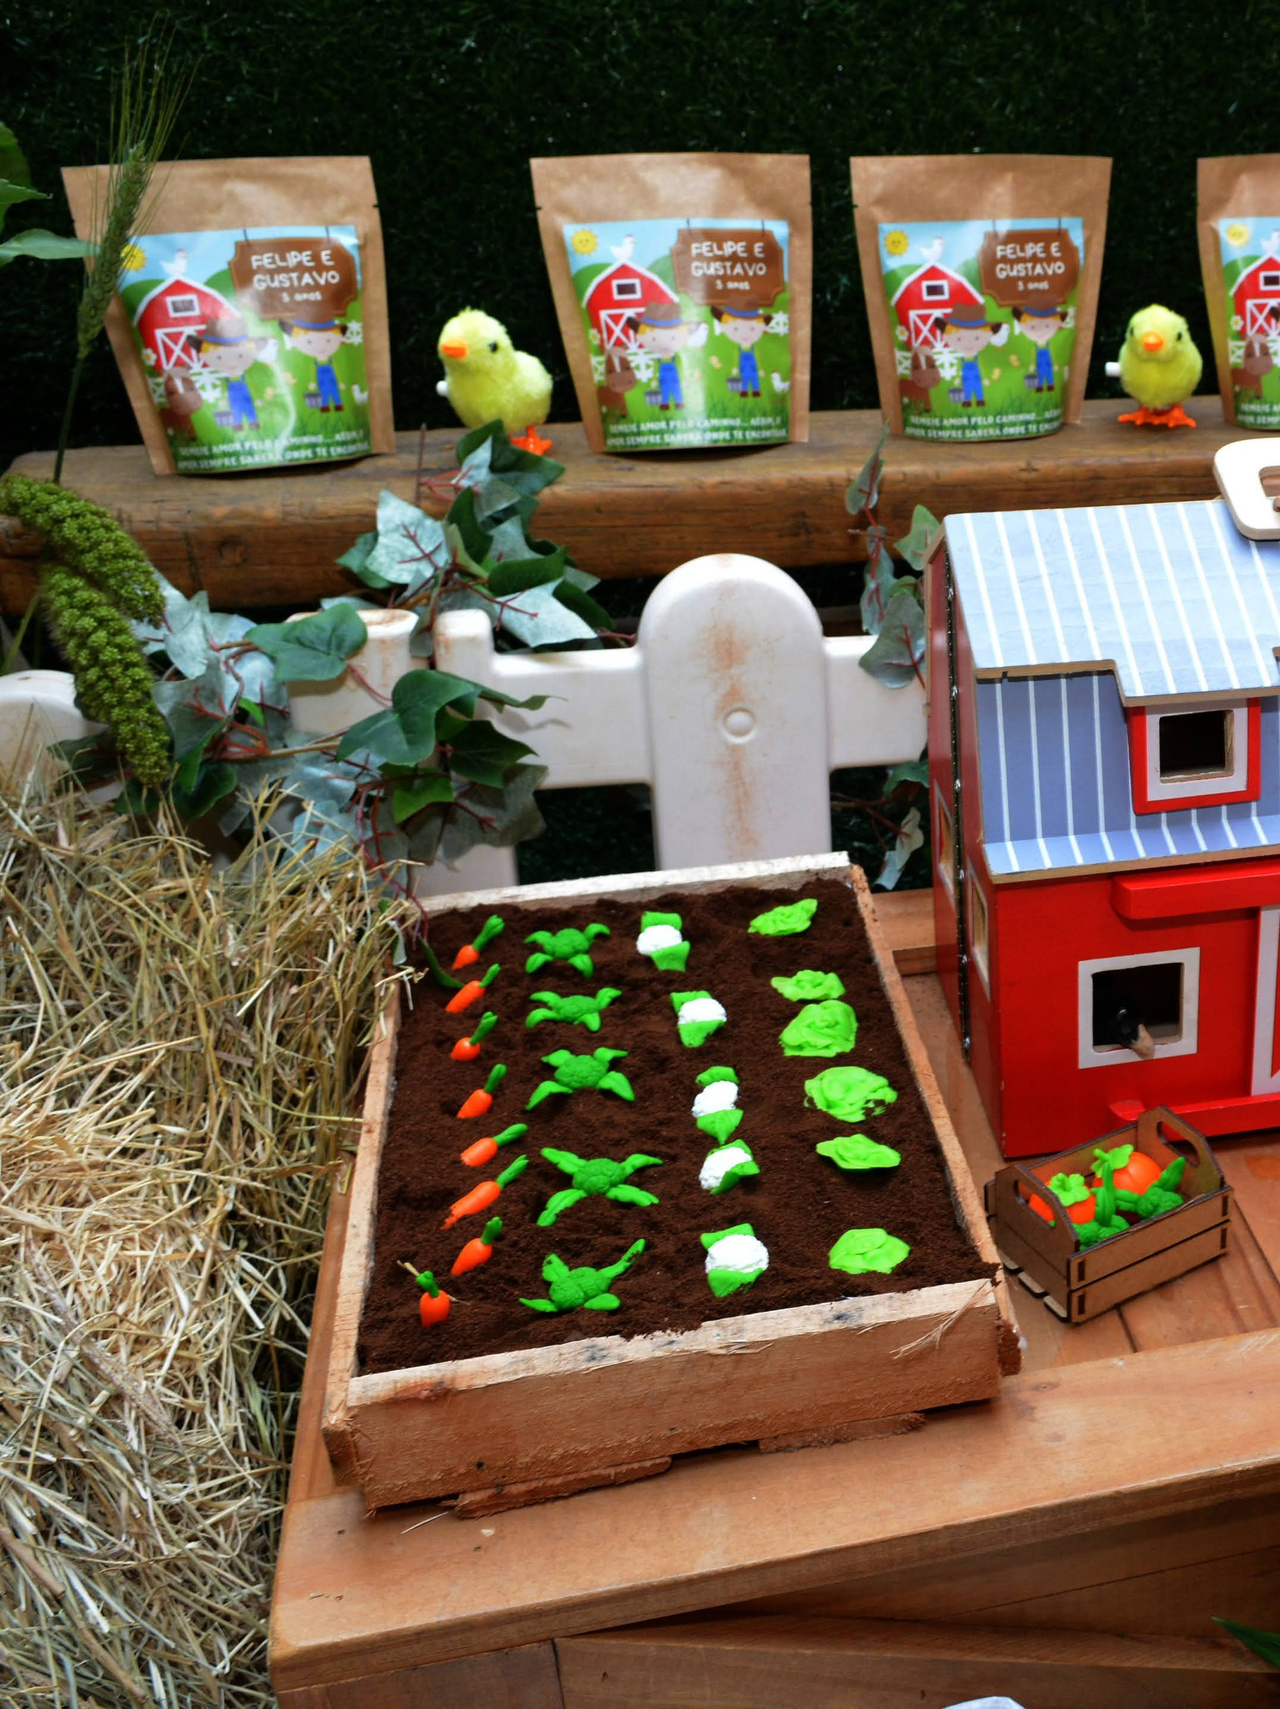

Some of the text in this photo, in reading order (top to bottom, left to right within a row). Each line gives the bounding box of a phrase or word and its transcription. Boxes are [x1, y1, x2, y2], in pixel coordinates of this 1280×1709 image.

[691, 241, 765, 258] FELIPE E
[996, 241, 1062, 259] FELIPE E
[251, 250, 335, 269] FELIPE E
[691, 261, 767, 277] GUSTAVO
[996, 261, 1065, 279] GUSTAVO
[252, 270, 340, 291] GUSTAVO
